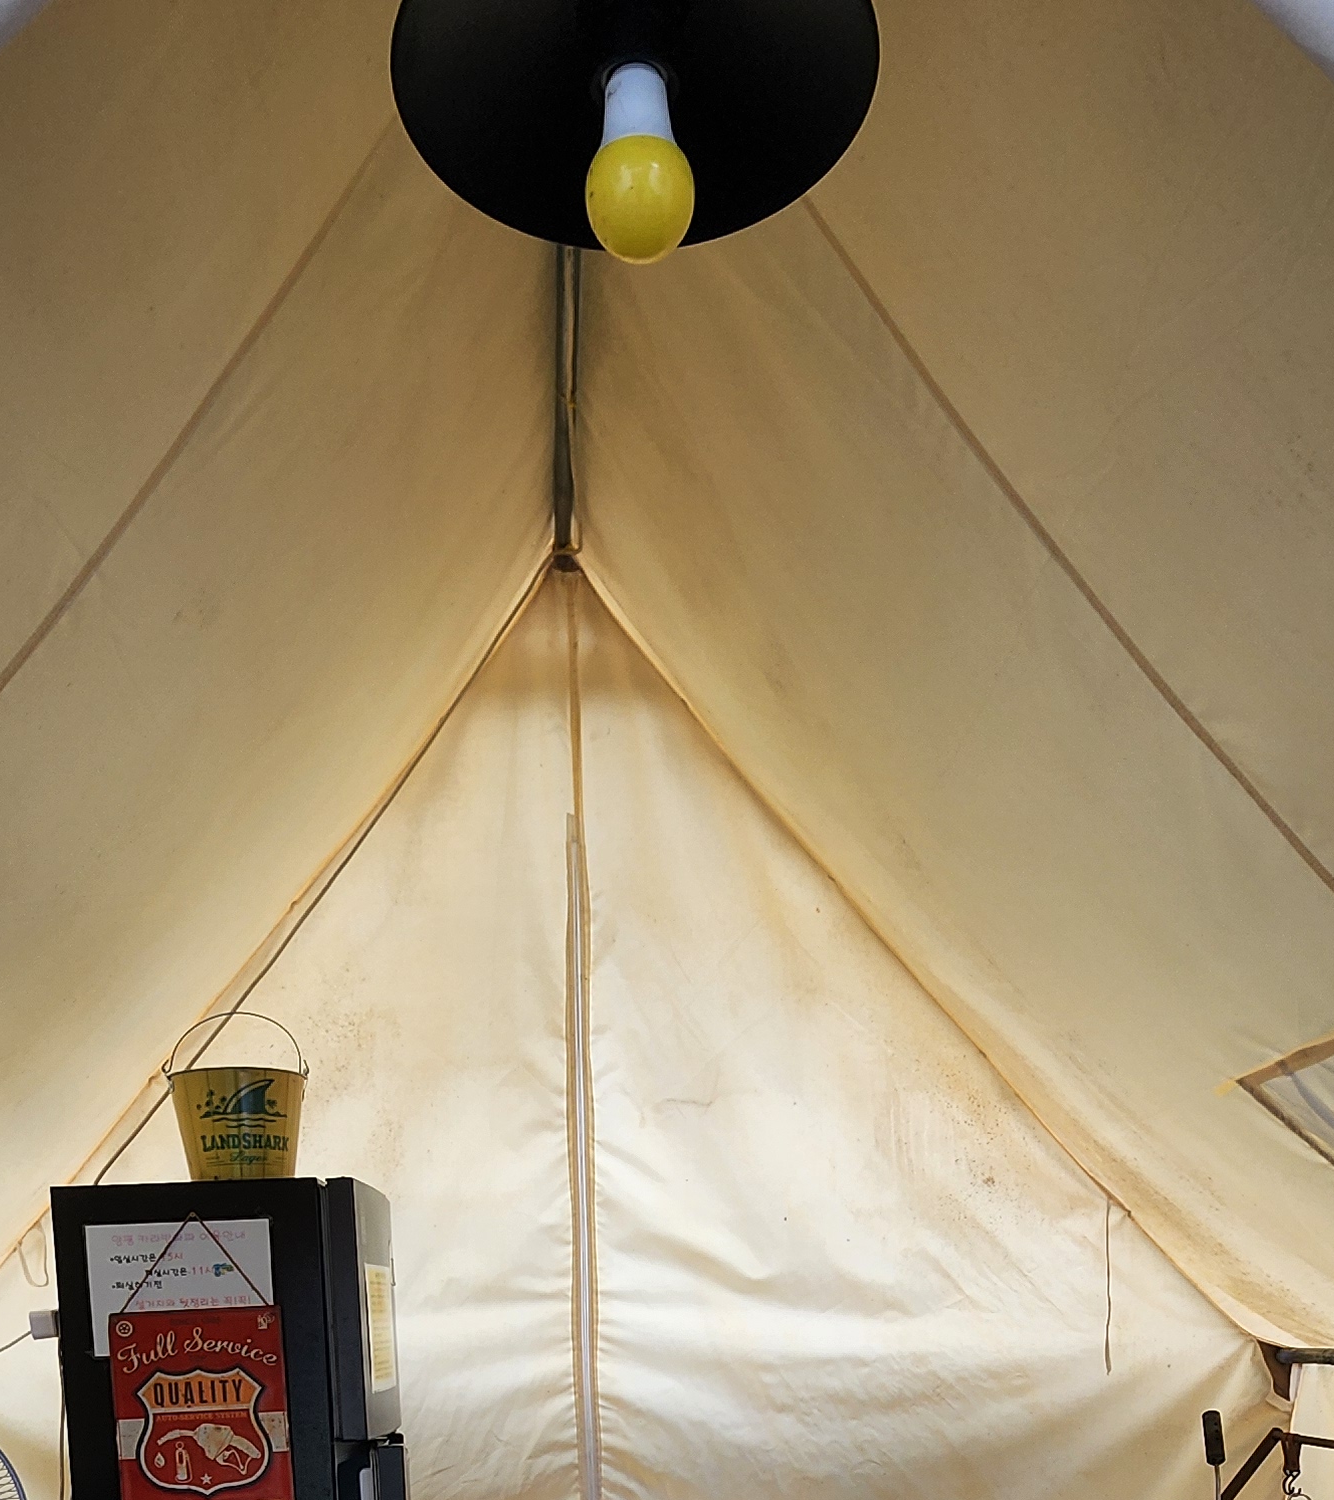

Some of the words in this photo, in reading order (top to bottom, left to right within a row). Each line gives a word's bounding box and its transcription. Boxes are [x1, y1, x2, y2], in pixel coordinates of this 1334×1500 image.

[200, 1132, 289, 1152] LANDSHARK
[117, 1330, 178, 1373] Full
[184, 1327, 277, 1366] Service
[153, 1379, 243, 1407] QUALITY
[156, 1413, 214, 1421] AUTO-SERVICE
[217, 1411, 248, 1419] SYSTEM
